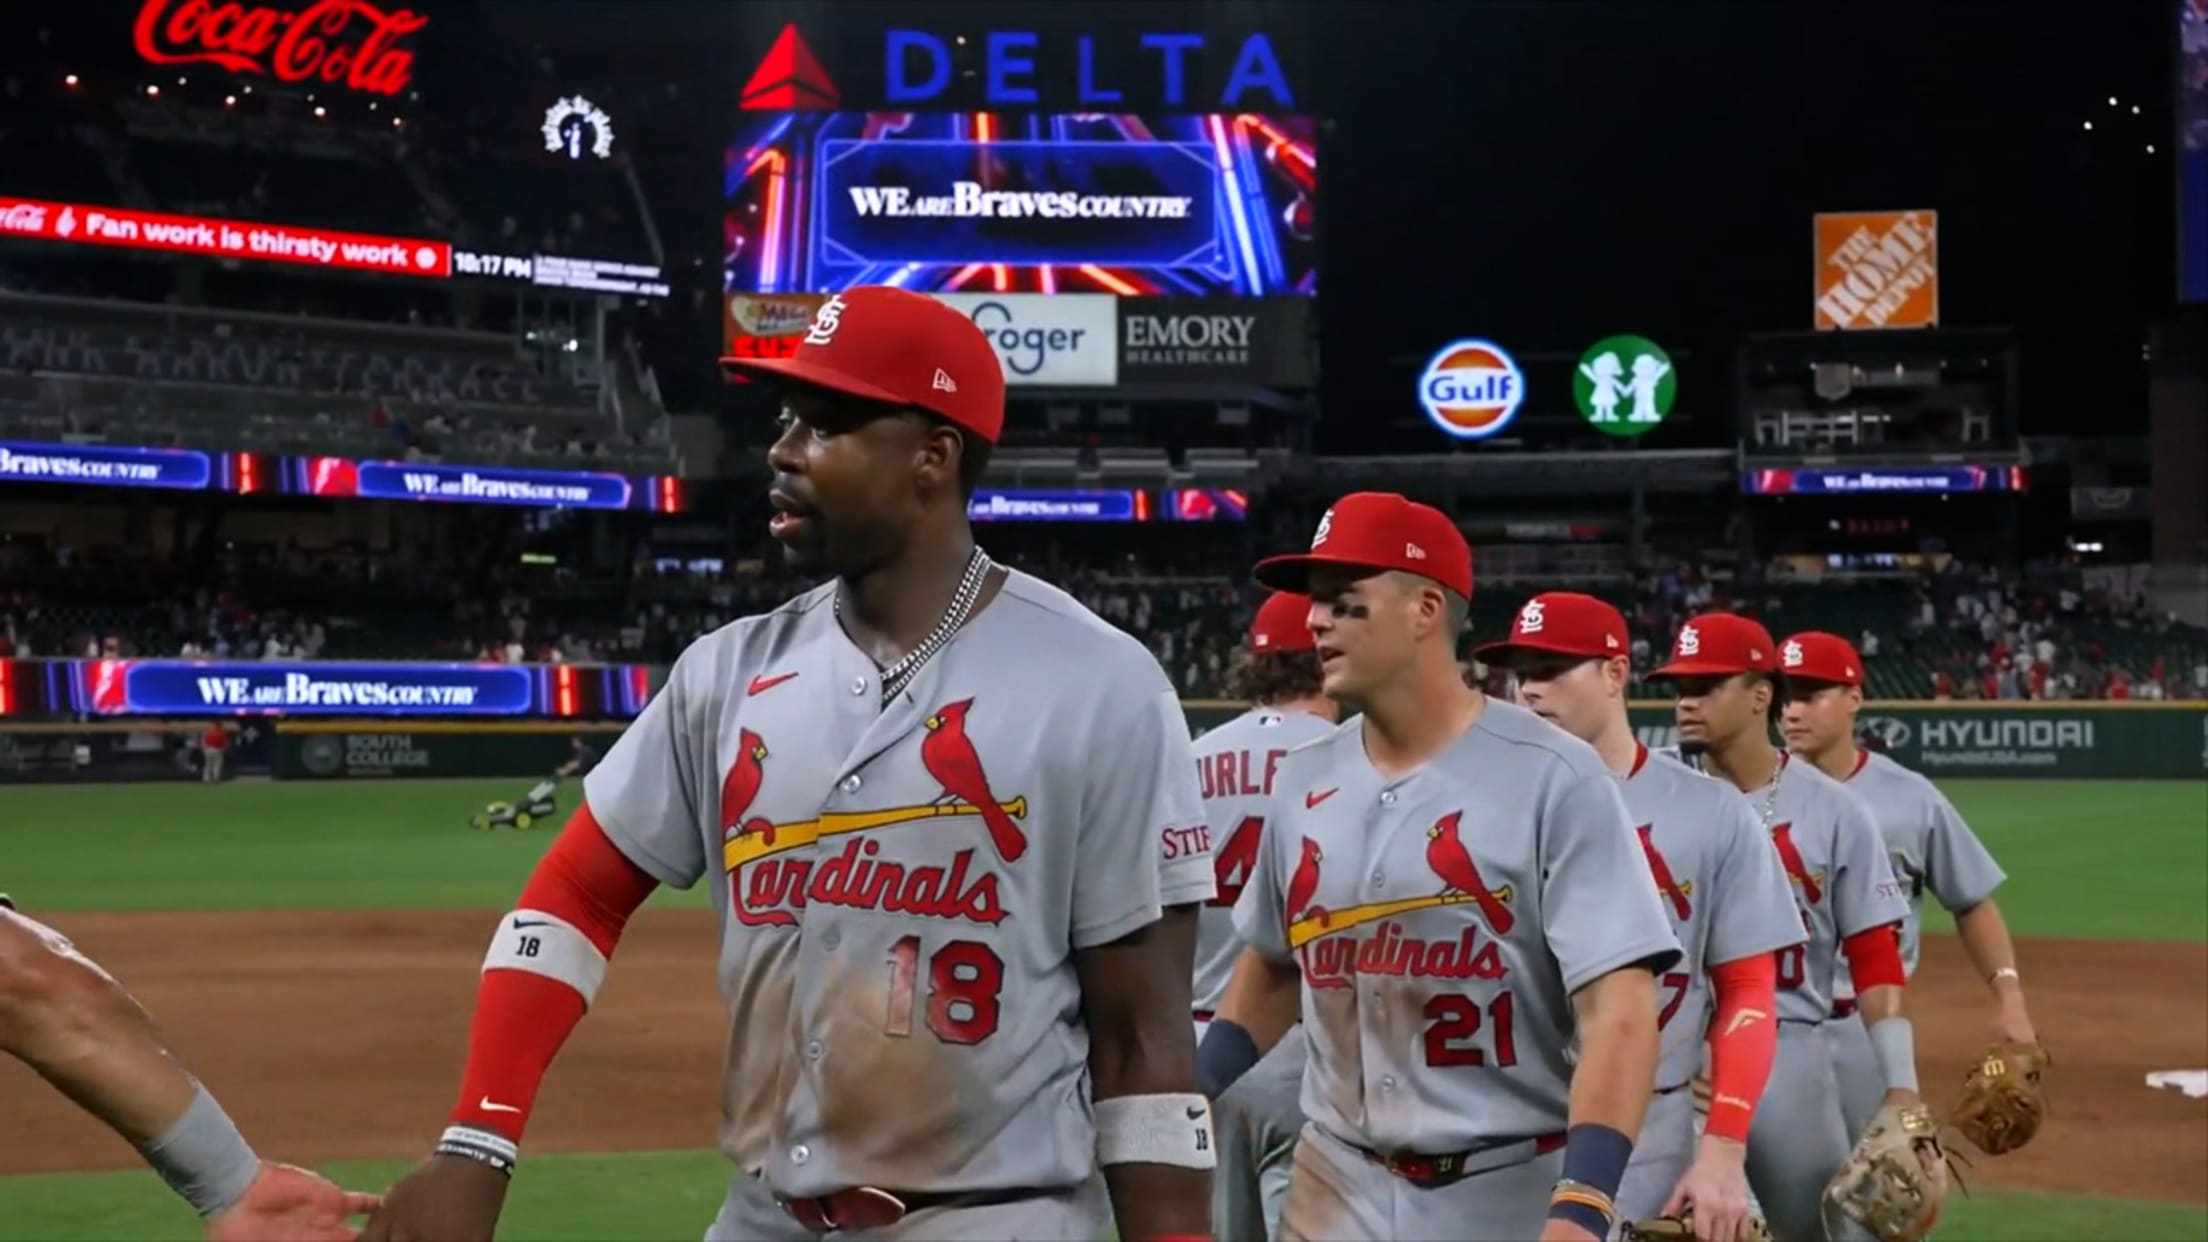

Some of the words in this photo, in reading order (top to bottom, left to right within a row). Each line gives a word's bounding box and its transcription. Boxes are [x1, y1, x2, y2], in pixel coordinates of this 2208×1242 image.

[133, 0, 429, 95] Coca-Cola
[884, 29, 1295, 106] DELTA
[86, 212, 138, 240] Fan
[143, 223, 215, 248] work
[220, 225, 244, 250] is
[248, 230, 338, 263] thirsty
[341, 242, 408, 267] work
[1828, 224, 1881, 273] THE
[503, 256, 531, 279] PM
[1816, 211, 1934, 330] HOME
[1865, 257, 1935, 327] DEPOT
[1126, 316, 1255, 348] EMORY
[1126, 350, 1249, 364] HEALTHCARE
[1428, 375, 1513, 402] Gulf
[347, 734, 411, 749] SOUTH
[1921, 720, 2094, 747] HYUNDAI
[346, 751, 430, 767] COLLEGE
[732, 836, 1011, 927] Cardinals
[516, 936, 541, 957] 18
[1303, 920, 1511, 989] Cardinals
[884, 934, 1005, 1046] 18
[1423, 988, 1517, 1068] 21
[1195, 1128, 1209, 1151] 18
